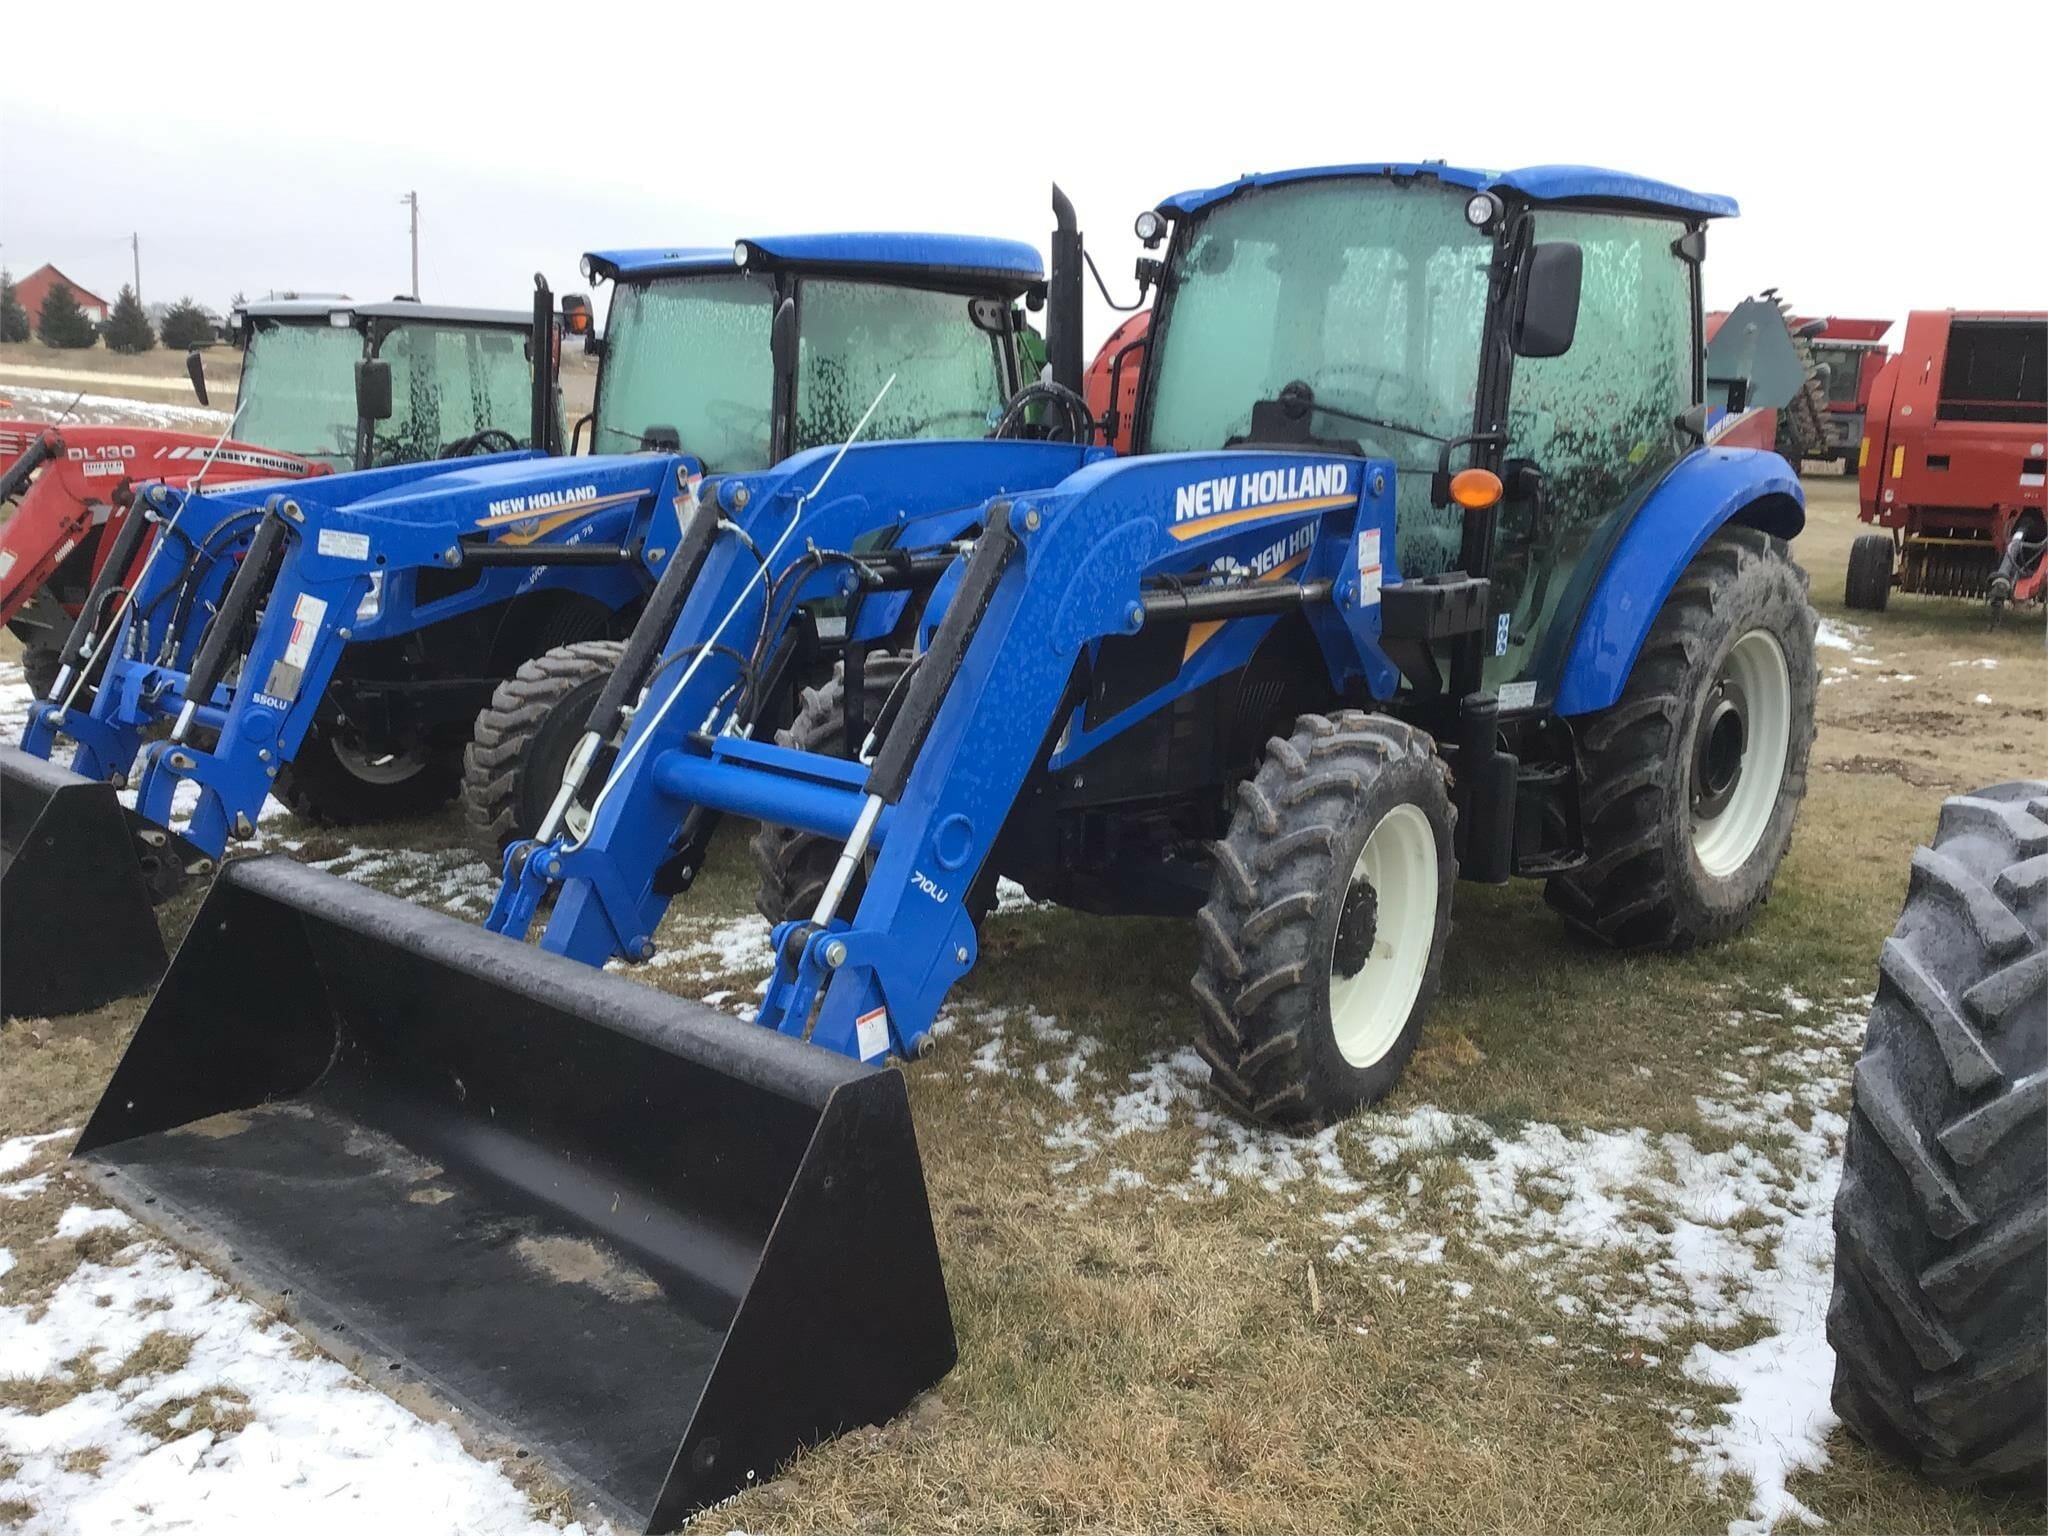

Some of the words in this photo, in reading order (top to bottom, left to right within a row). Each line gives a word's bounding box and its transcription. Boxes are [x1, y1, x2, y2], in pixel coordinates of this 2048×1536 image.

[67, 445, 136, 461] DL130
[203, 450, 247, 462] MASSEY
[249, 456, 304, 473] FERGUSON
[489, 497, 525, 517] NEW
[528, 485, 597, 510] HOLLAND
[1175, 476, 1237, 521] NEW
[1241, 463, 1348, 507] HOLLAND
[1250, 538, 1286, 576] NEW
[252, 692, 288, 711] 550LU
[910, 870, 948, 904] 710LU
